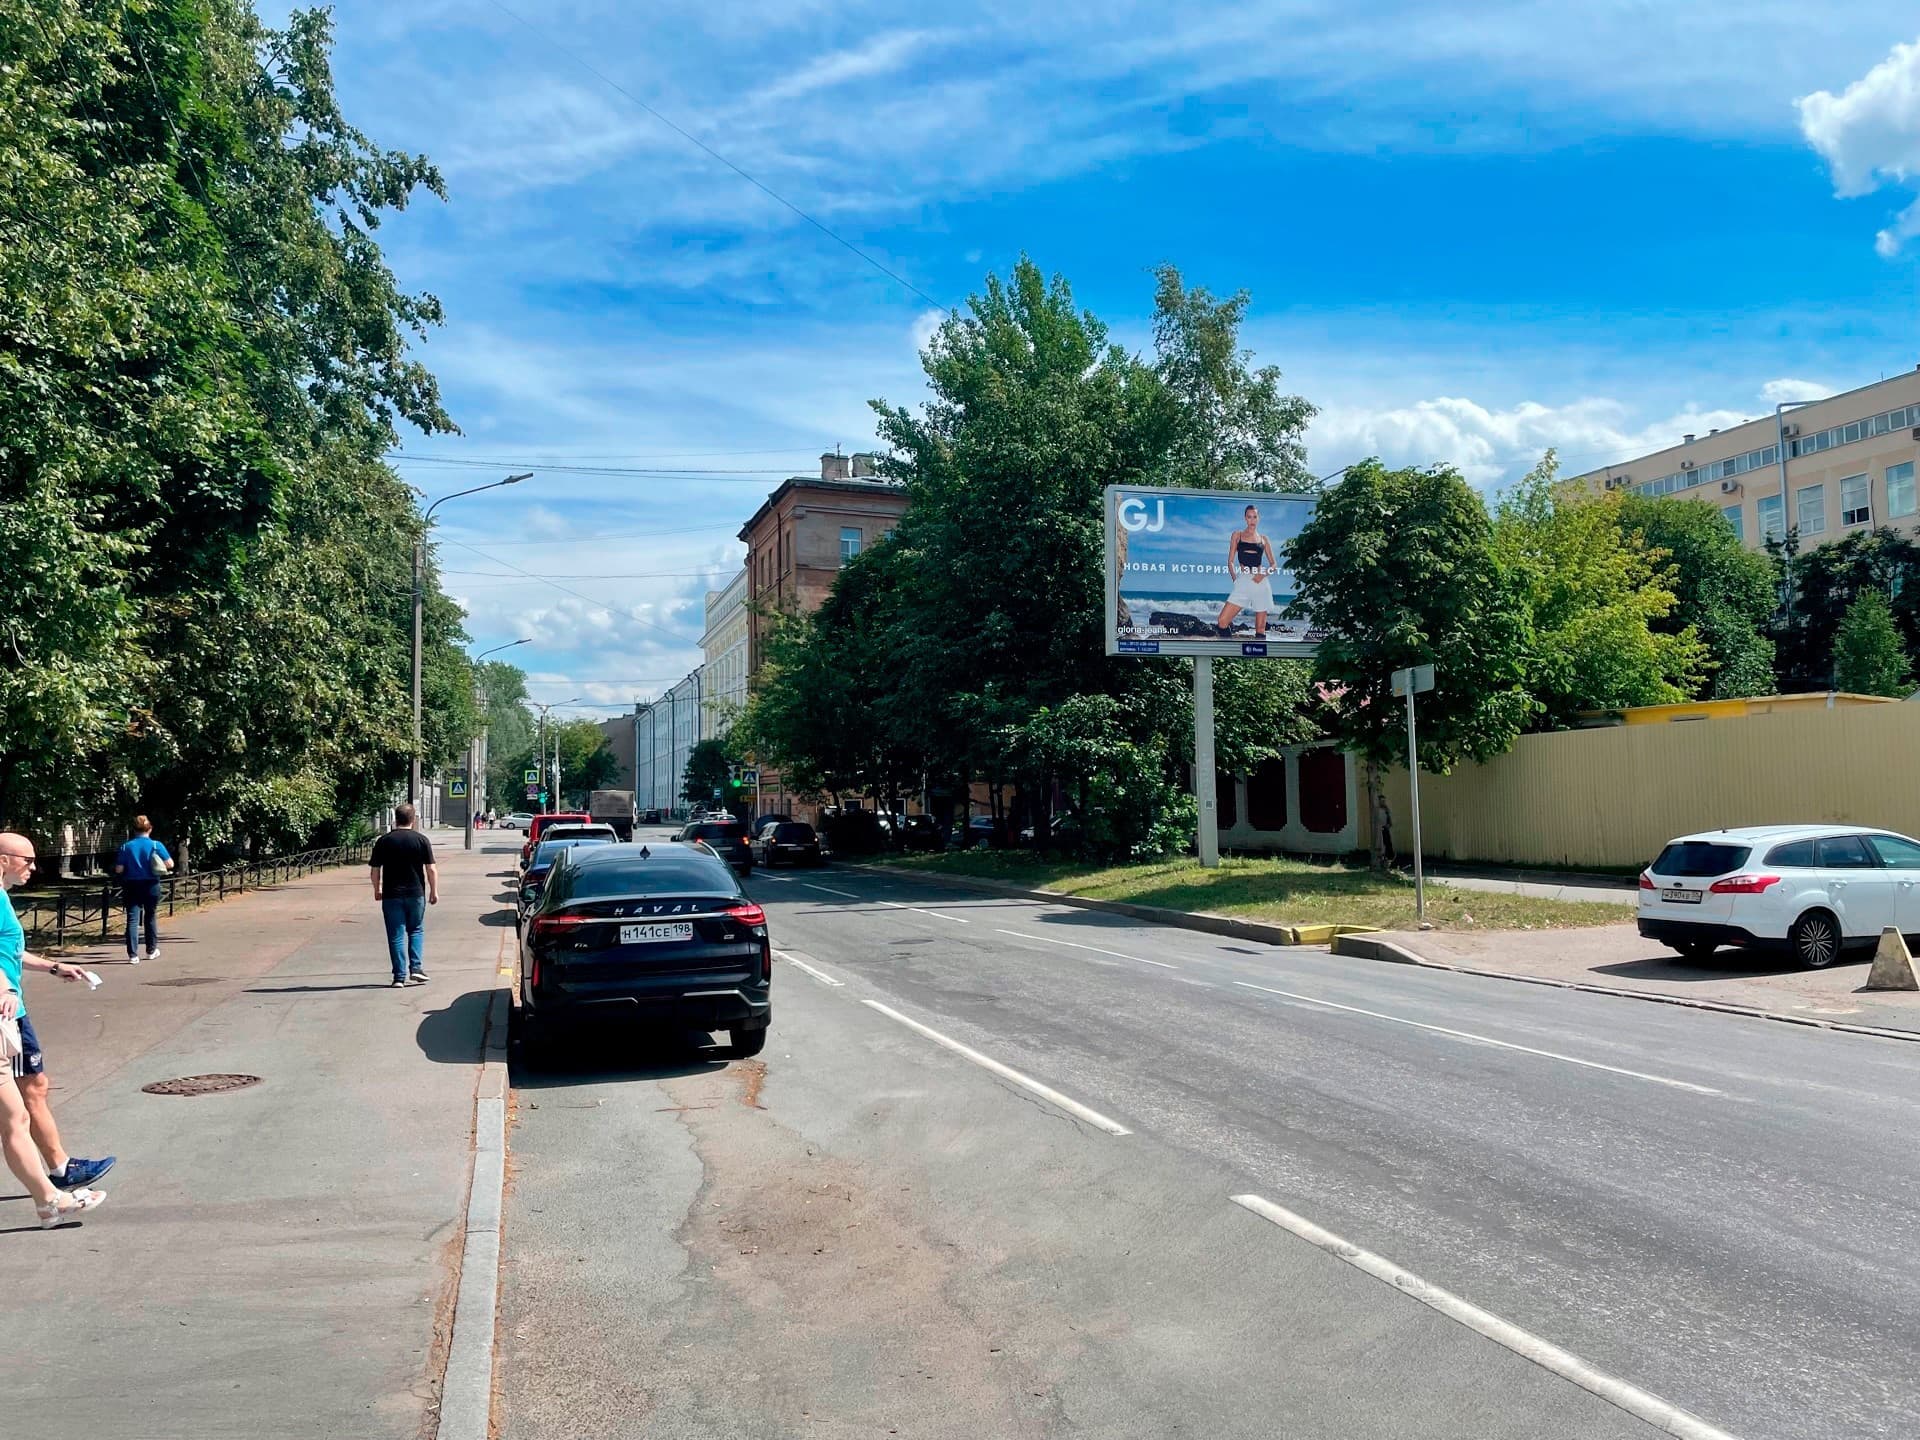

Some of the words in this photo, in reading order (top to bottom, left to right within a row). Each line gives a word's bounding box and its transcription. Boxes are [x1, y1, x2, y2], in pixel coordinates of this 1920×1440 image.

[1118, 498, 1165, 532] GJ
[1123, 562, 1166, 572] НОВАЯ
[1171, 564, 1229, 574] ИСТОРИЯ
[614, 904, 699, 916] HAVAL
[673, 923, 691, 933] 198
